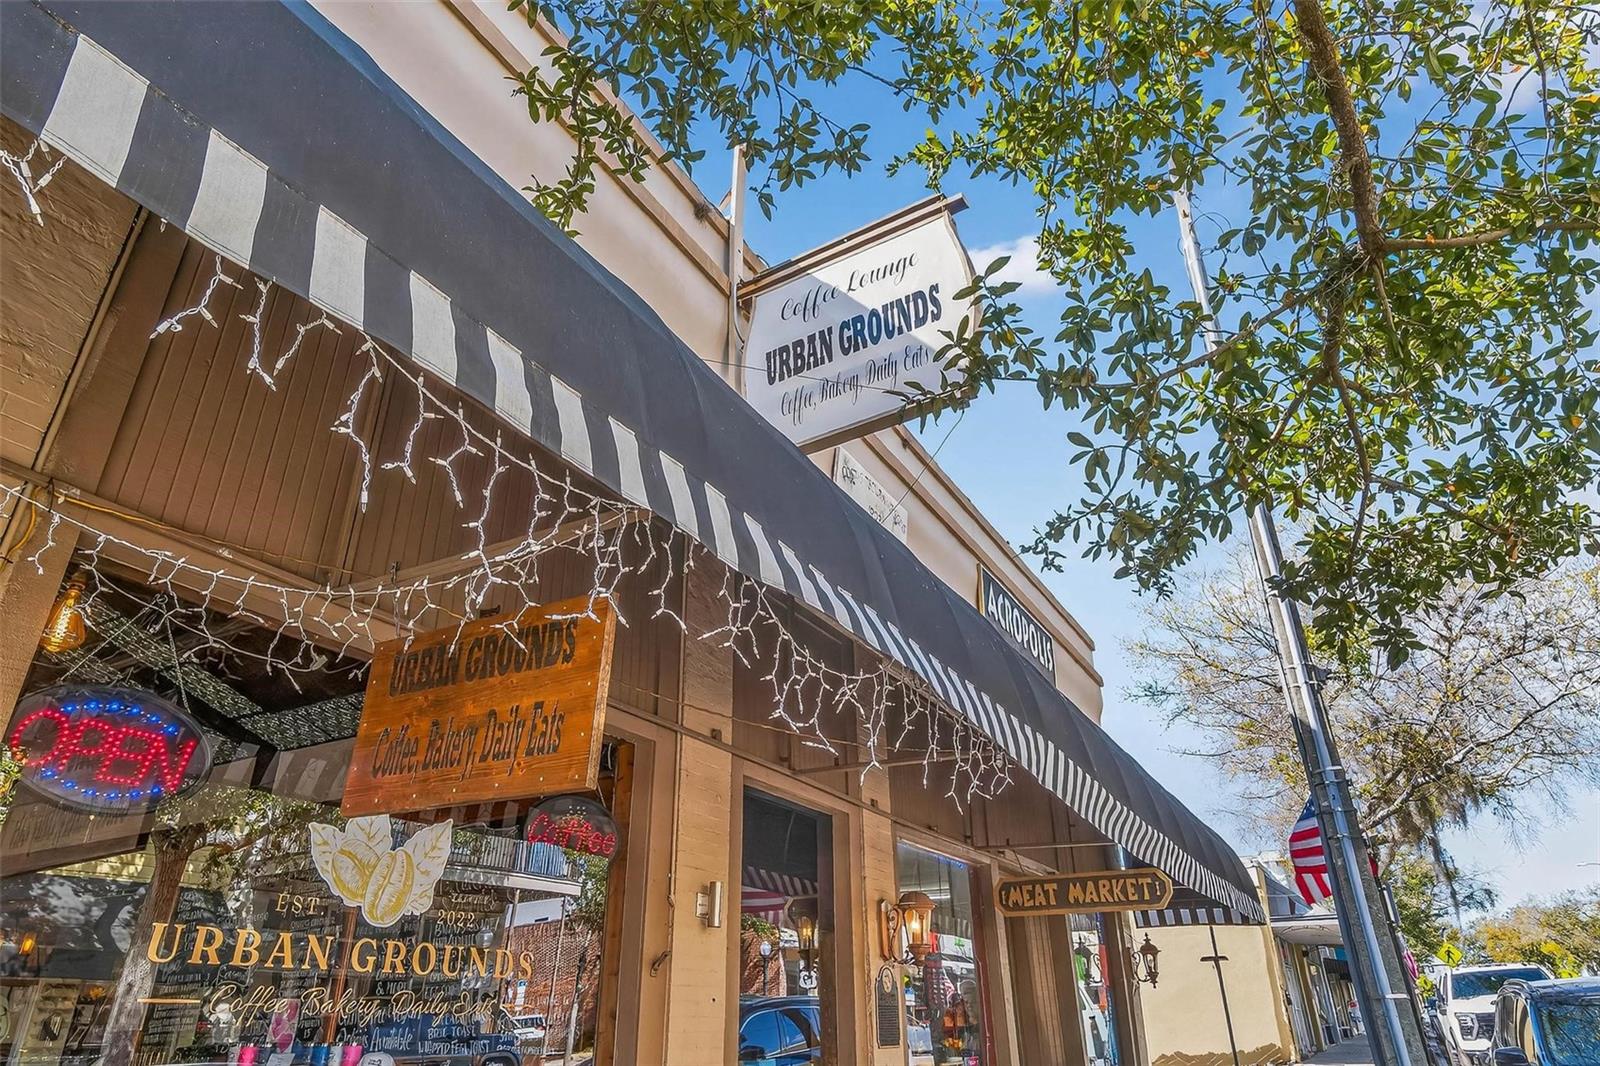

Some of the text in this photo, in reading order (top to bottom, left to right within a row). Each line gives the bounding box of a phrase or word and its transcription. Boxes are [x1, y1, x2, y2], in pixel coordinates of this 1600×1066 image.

[780, 251, 920, 323] Coffee Lounge
[765, 282, 943, 386] URBAN GROUNDS
[780, 384, 818, 426] Coffee,
[865, 350, 899, 387] Daily
[902, 344, 930, 372] Eats
[388, 616, 578, 698] URBAN GROUNDS
[987, 581, 1053, 672] ACROPOLIS
[9, 707, 199, 795] OPEN
[372, 724, 419, 784] Coffee,
[478, 704, 526, 776] Daily
[525, 699, 565, 757] Eats
[528, 812, 617, 856] Coffee
[275, 892, 475, 929] EST. 2022
[1008, 877, 1152, 908] MEAT MARKET
[147, 922, 335, 970] URBAN
[350, 937, 536, 981] GROUNDS
[389, 990, 450, 1026] Daily
[452, 990, 499, 1018] Eats
